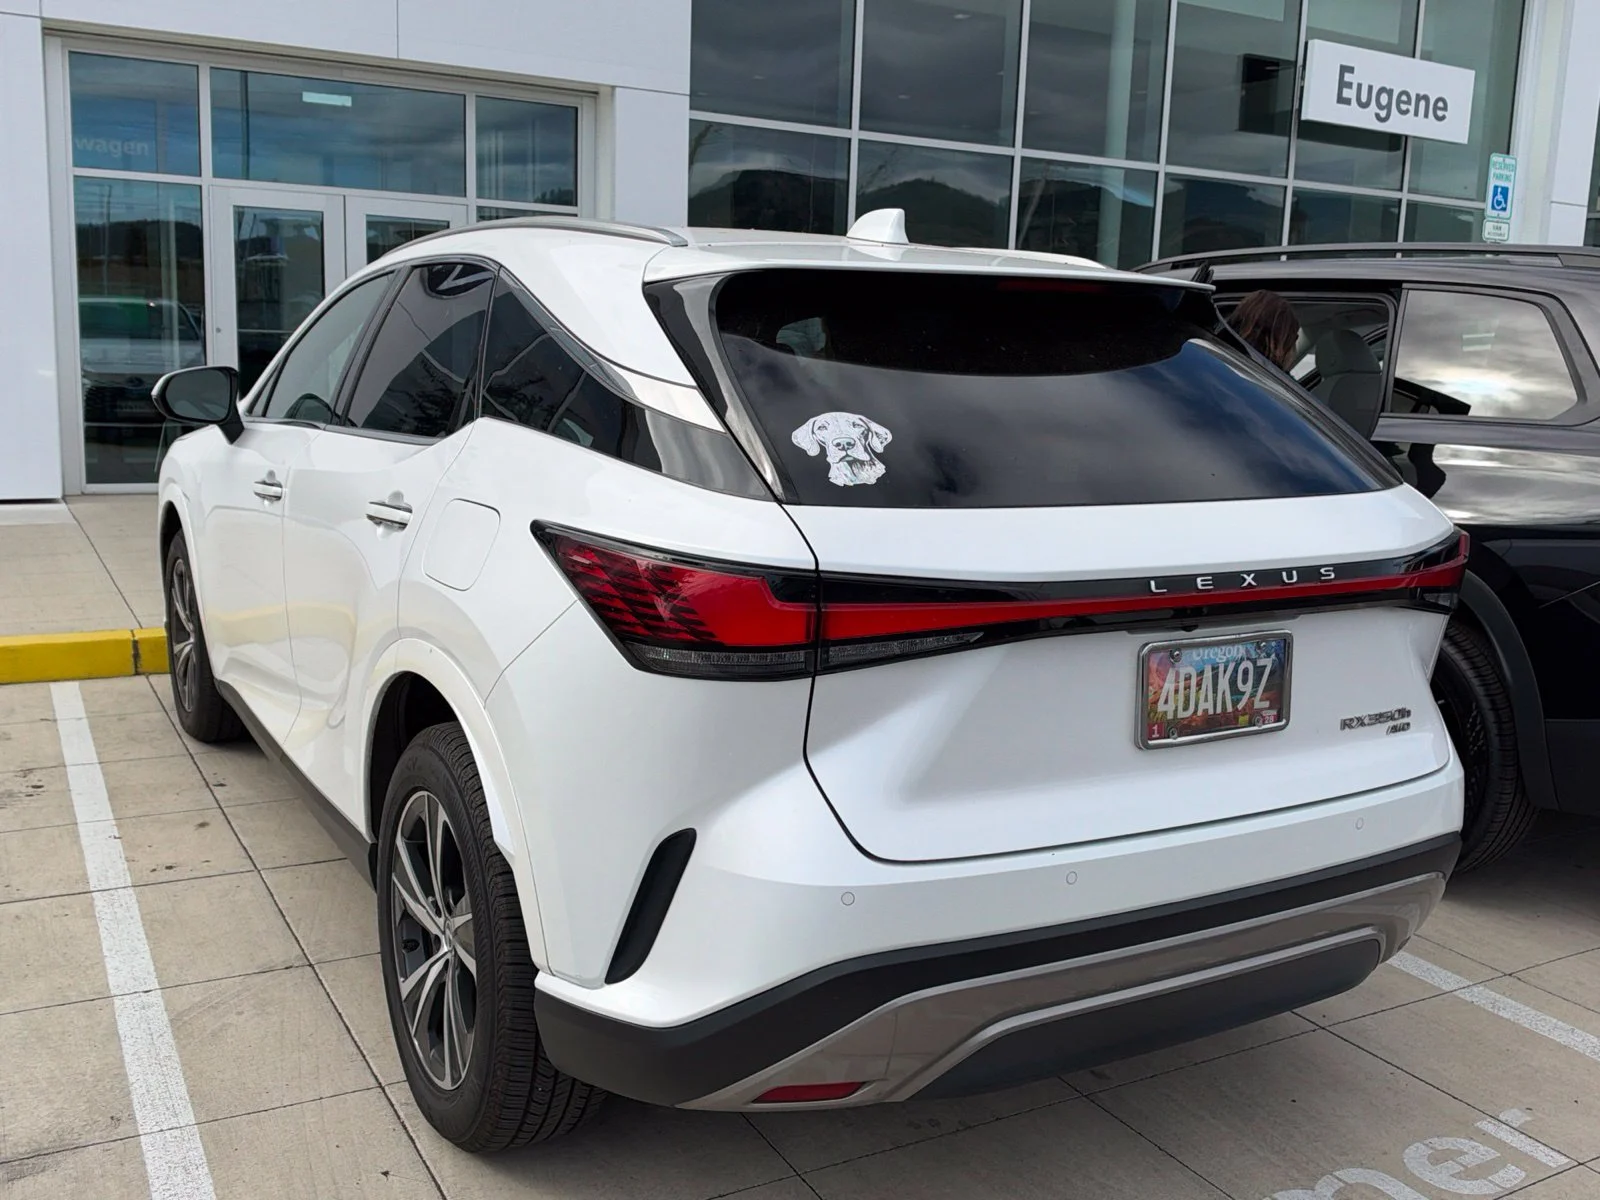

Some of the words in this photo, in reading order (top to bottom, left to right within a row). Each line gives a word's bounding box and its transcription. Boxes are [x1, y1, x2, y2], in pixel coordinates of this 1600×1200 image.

[1336, 64, 1448, 123] Eugene
[74, 138, 149, 157] wagen
[1150, 567, 1336, 593] LEXUS
[1192, 644, 1244, 662] Oregon
[1157, 658, 1274, 719] 4DAK9Z
[1151, 724, 1160, 738] 1
